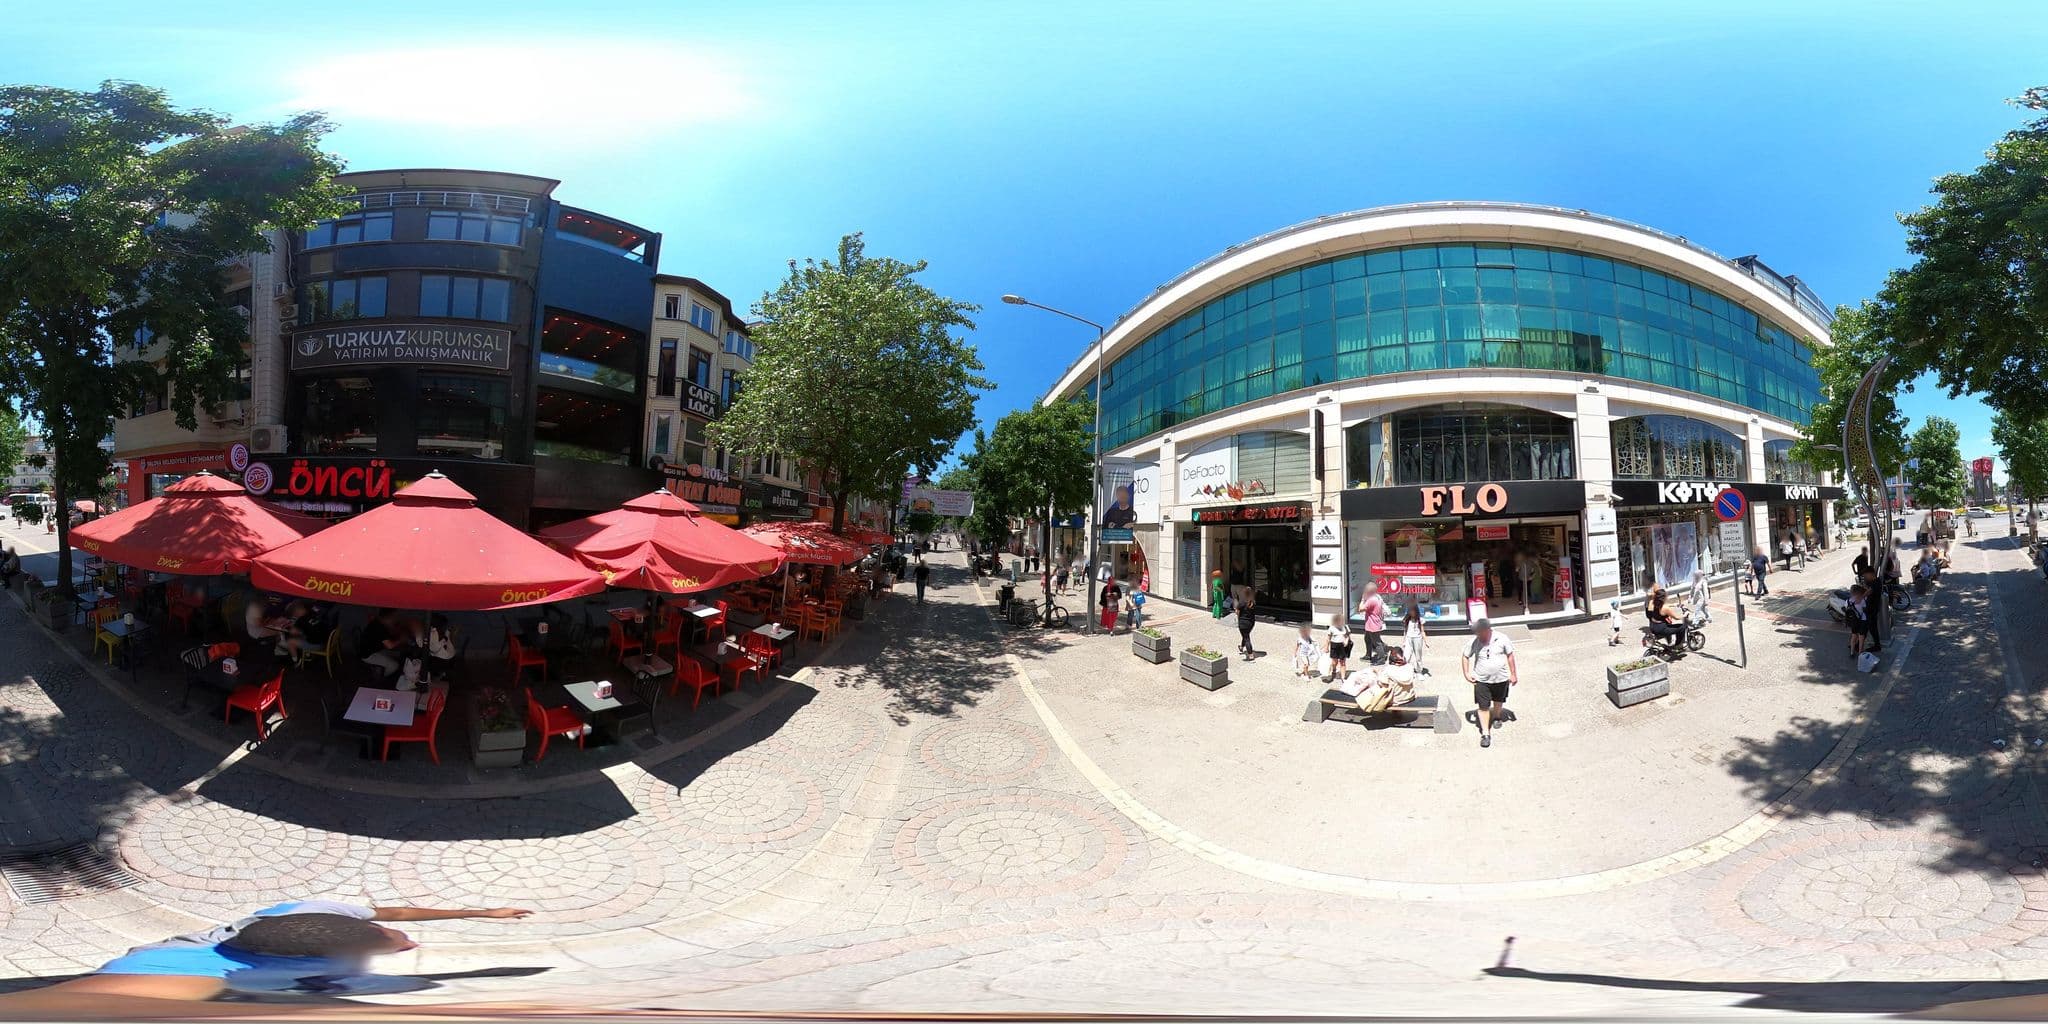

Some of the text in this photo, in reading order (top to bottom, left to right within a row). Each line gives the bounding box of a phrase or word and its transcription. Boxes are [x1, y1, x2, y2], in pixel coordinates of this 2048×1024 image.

[334, 347, 493, 362] YATIRIM DANIŞMANLIK
[688, 385, 716, 405] CAFE
[688, 398, 715, 418] LOCA
[1183, 464, 1225, 481] DeFacto
[1420, 483, 1508, 516] FLO
[1375, 577, 1402, 594] 20
